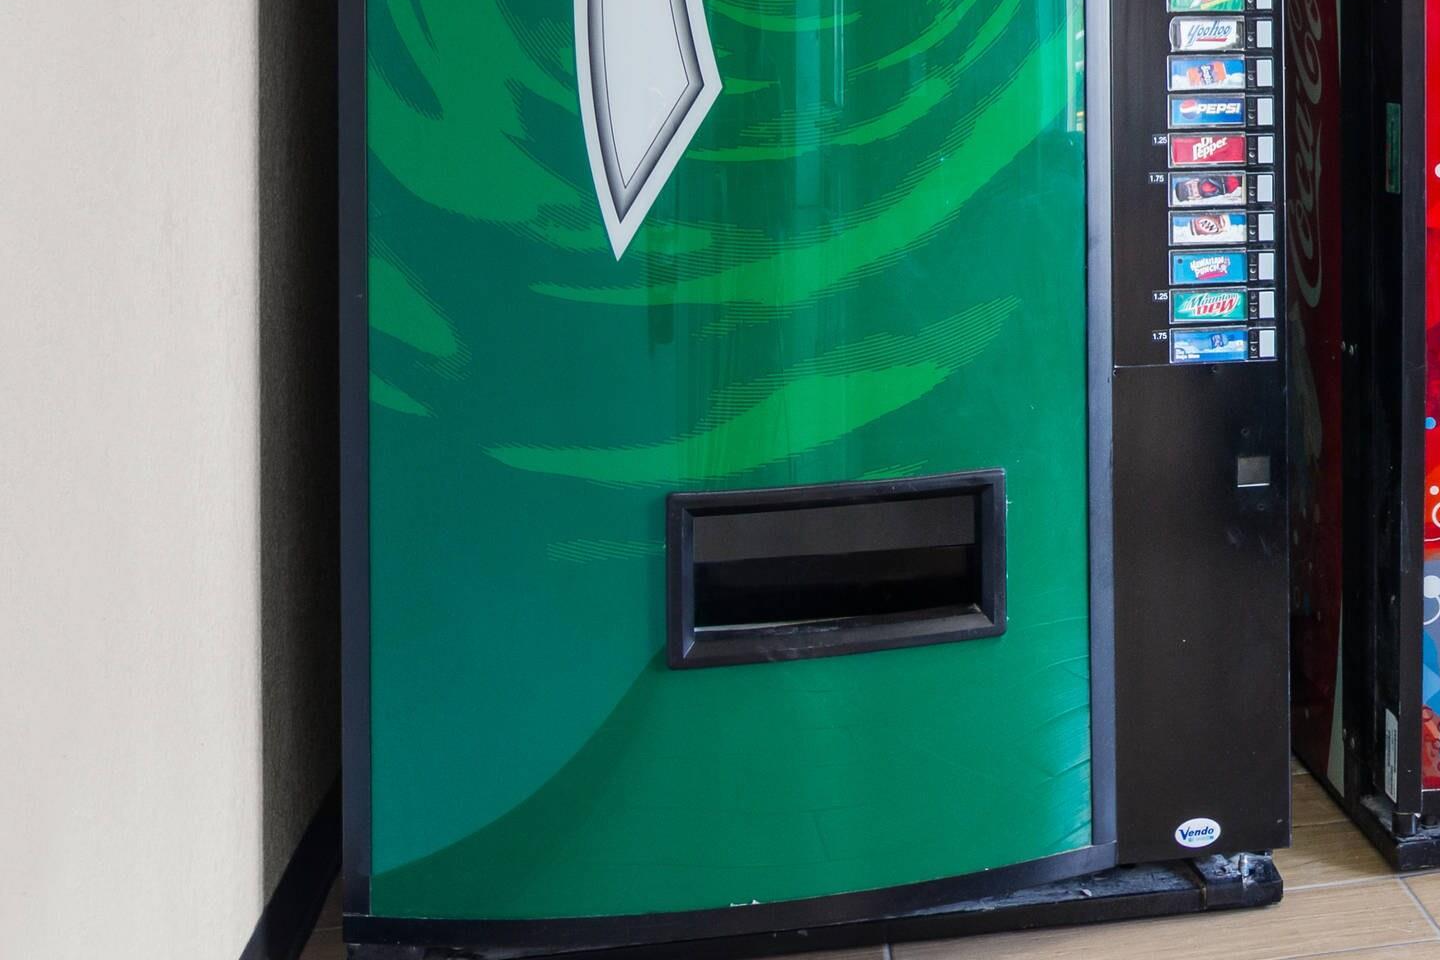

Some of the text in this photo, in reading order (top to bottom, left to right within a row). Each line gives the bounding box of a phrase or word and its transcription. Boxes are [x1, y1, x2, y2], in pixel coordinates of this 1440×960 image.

[1196, 102, 1241, 115] PEPSI
[1152, 332, 1167, 340] 1.75
[1178, 826, 1215, 841] Vendo
